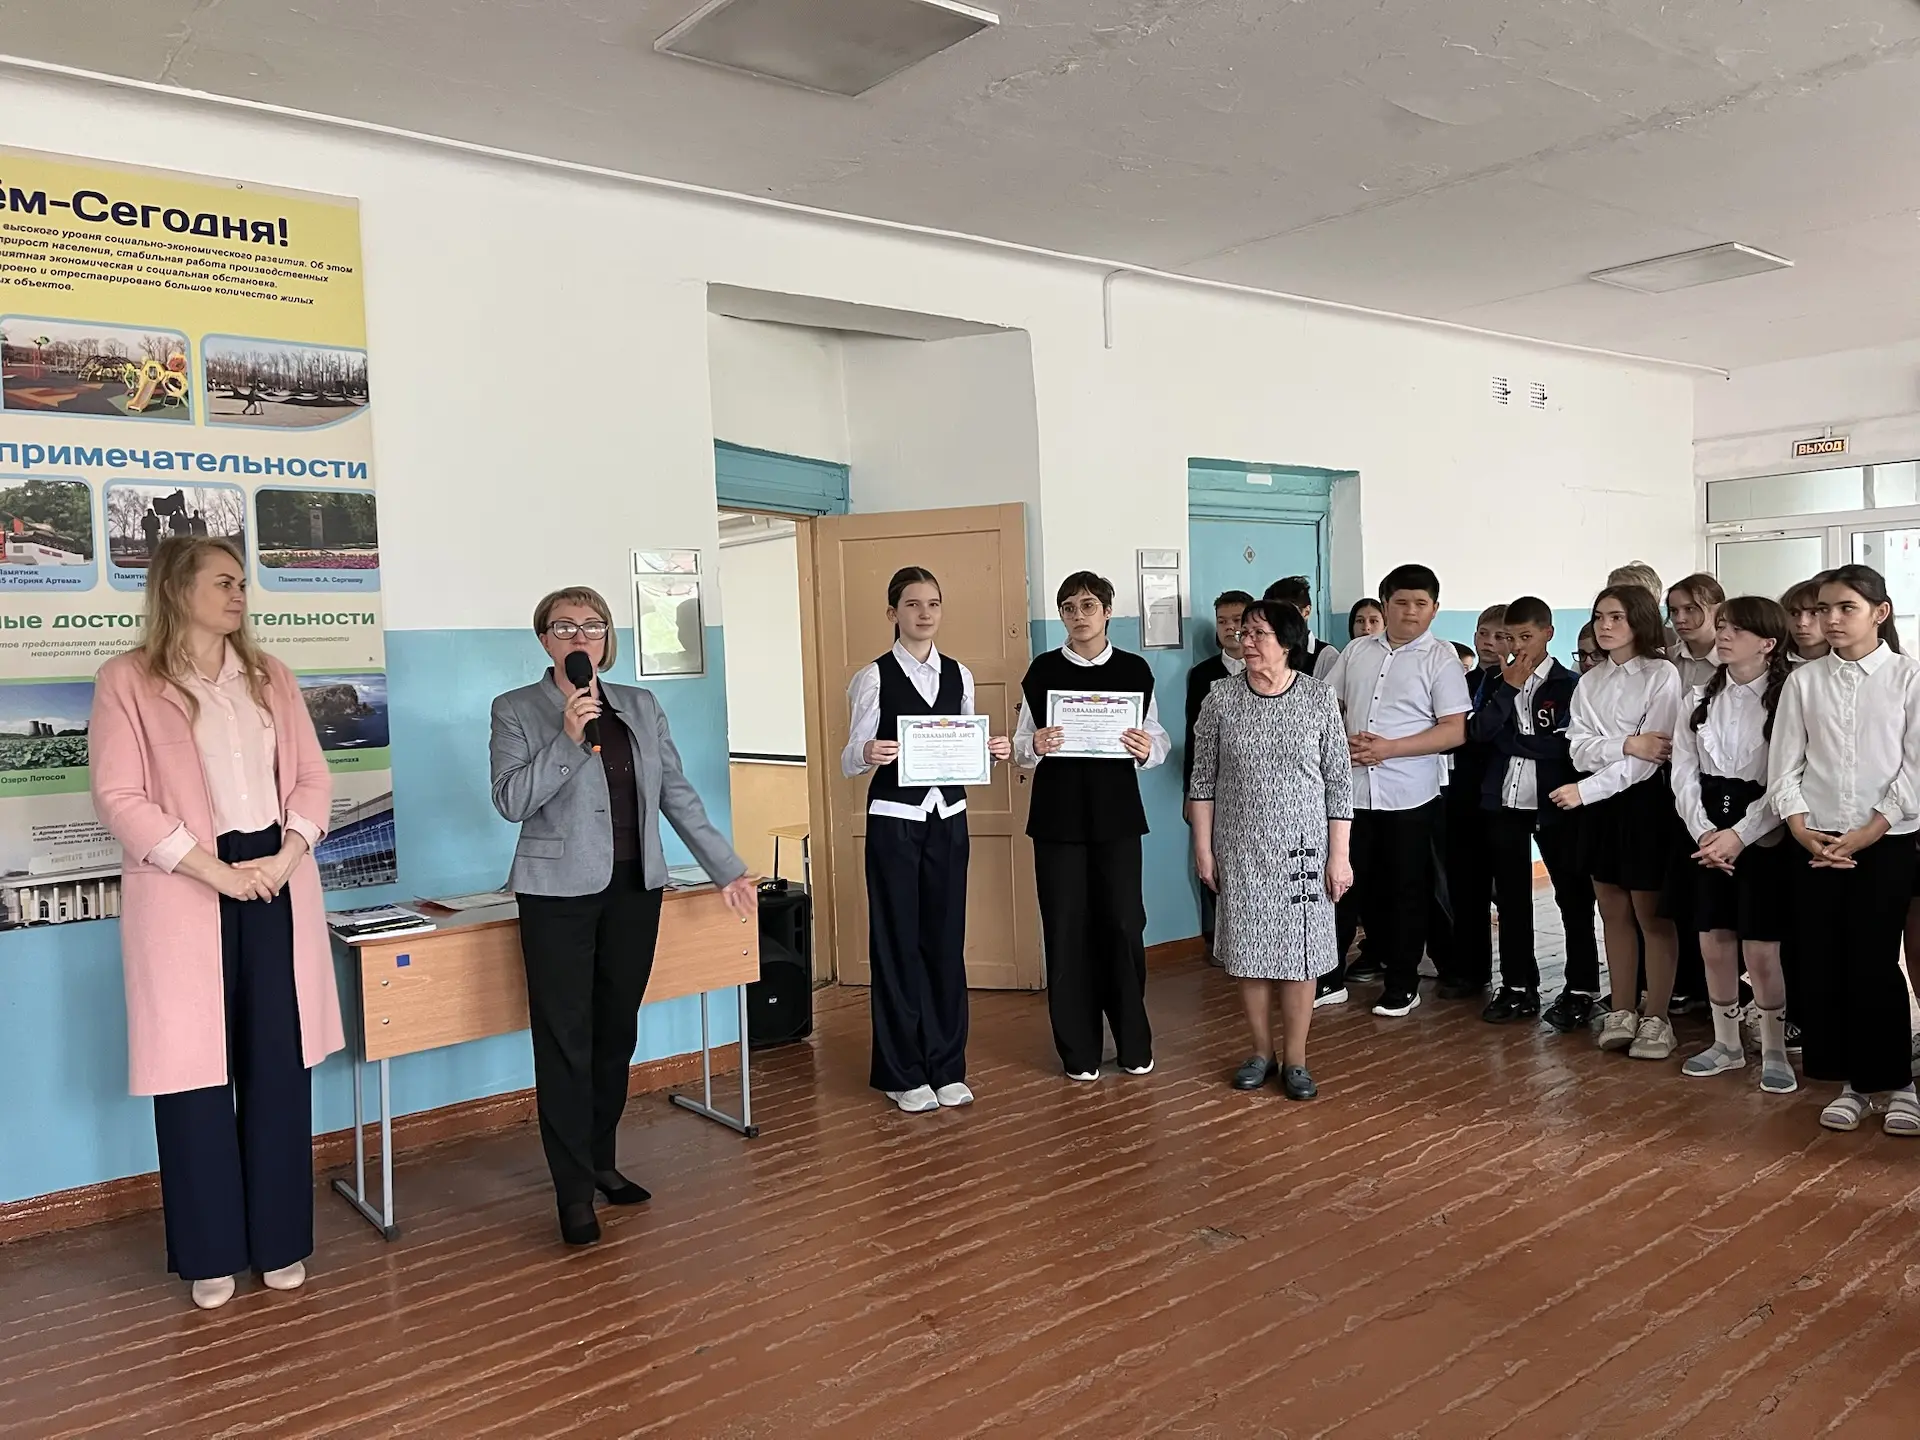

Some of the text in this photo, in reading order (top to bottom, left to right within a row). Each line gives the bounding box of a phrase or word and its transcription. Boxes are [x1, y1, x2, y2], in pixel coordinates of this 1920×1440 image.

[0, 180, 288, 247] м-Сегодня!
[3, 223, 353, 273] высокого уровня социально-экономического развития. Об этом
[0, 250, 46, 261] иятная
[49, 255, 133, 270] экономическая
[146, 266, 209, 280] социальная
[212, 274, 278, 288] обстановка.
[52, 241, 113, 256] населения,
[116, 249, 183, 263] стабильная
[186, 258, 226, 269] работа
[229, 263, 329, 282] производственных
[0, 263, 37, 274] роено
[50, 269, 161, 287] отреставрировано
[164, 280, 212, 293] большое
[215, 288, 278, 300] количество
[280, 295, 314, 305] жилых
[14, 278, 74, 291] объектов.
[1799, 441, 1842, 454] ВЫХОД
[0, 614, 42, 629] ые
[22, 639, 97, 649] представляет
[0, 776, 28, 784] Озеро
